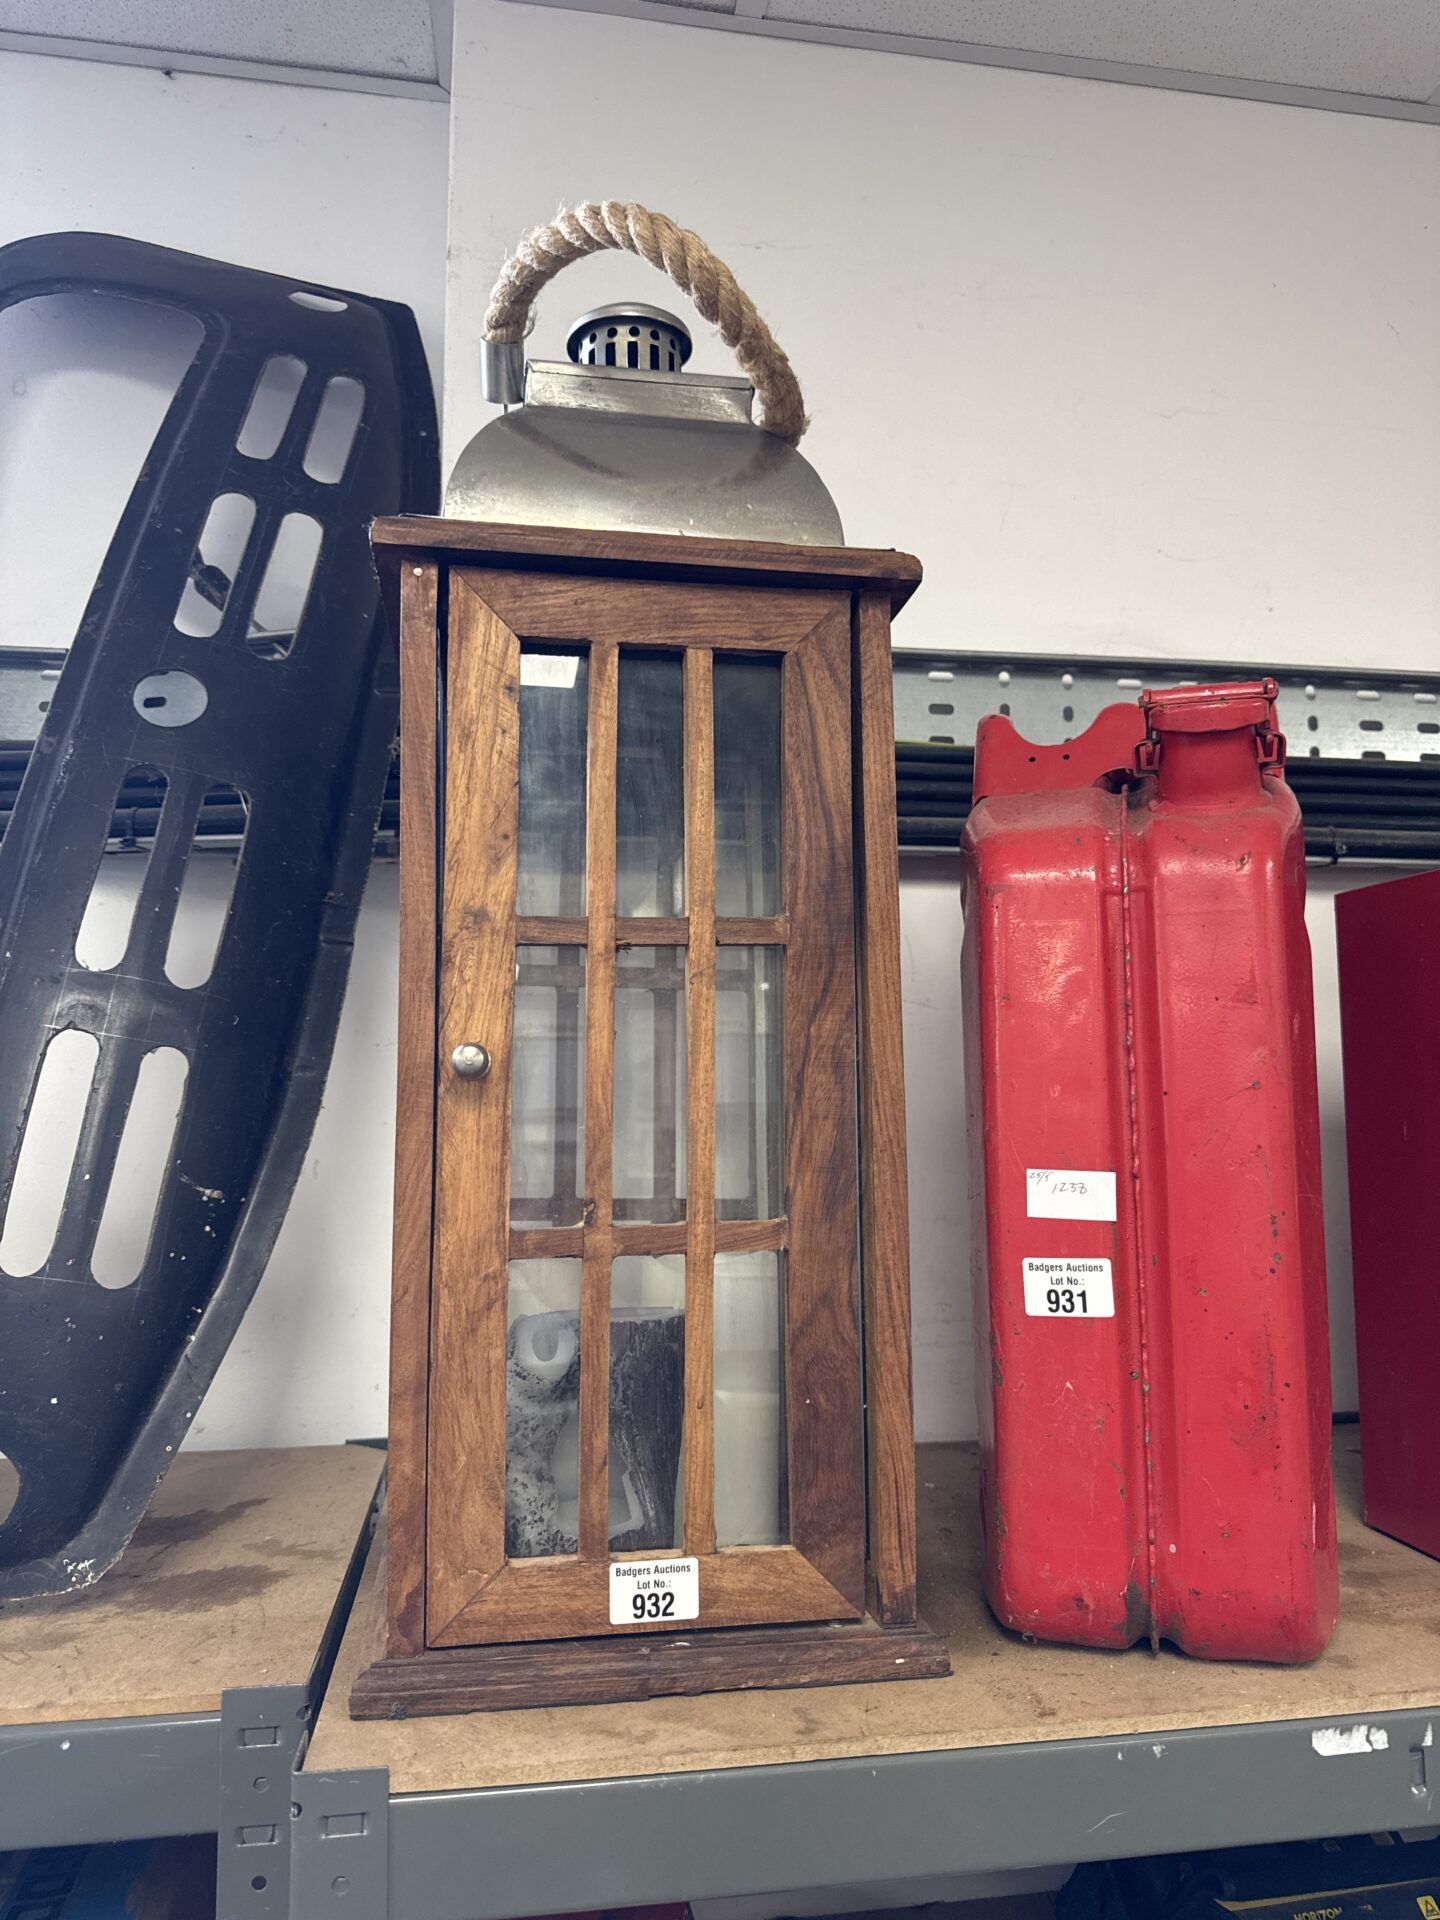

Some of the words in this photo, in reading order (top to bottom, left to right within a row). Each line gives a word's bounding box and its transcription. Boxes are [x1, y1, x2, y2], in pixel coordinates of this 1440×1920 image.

[1028, 1263, 1063, 1273] Badgers
[1066, 1263, 1104, 1273] Auctions
[1050, 1277, 1064, 1286] Lot
[1066, 1277, 1085, 1286] No.:
[1046, 1289, 1088, 1313] 931
[615, 1566, 651, 1577] Badgers
[653, 1564, 691, 1574] Auctions
[637, 1580, 650, 1590] Lot
[653, 1579, 672, 1589] No.:
[632, 1591, 675, 1619] 932
